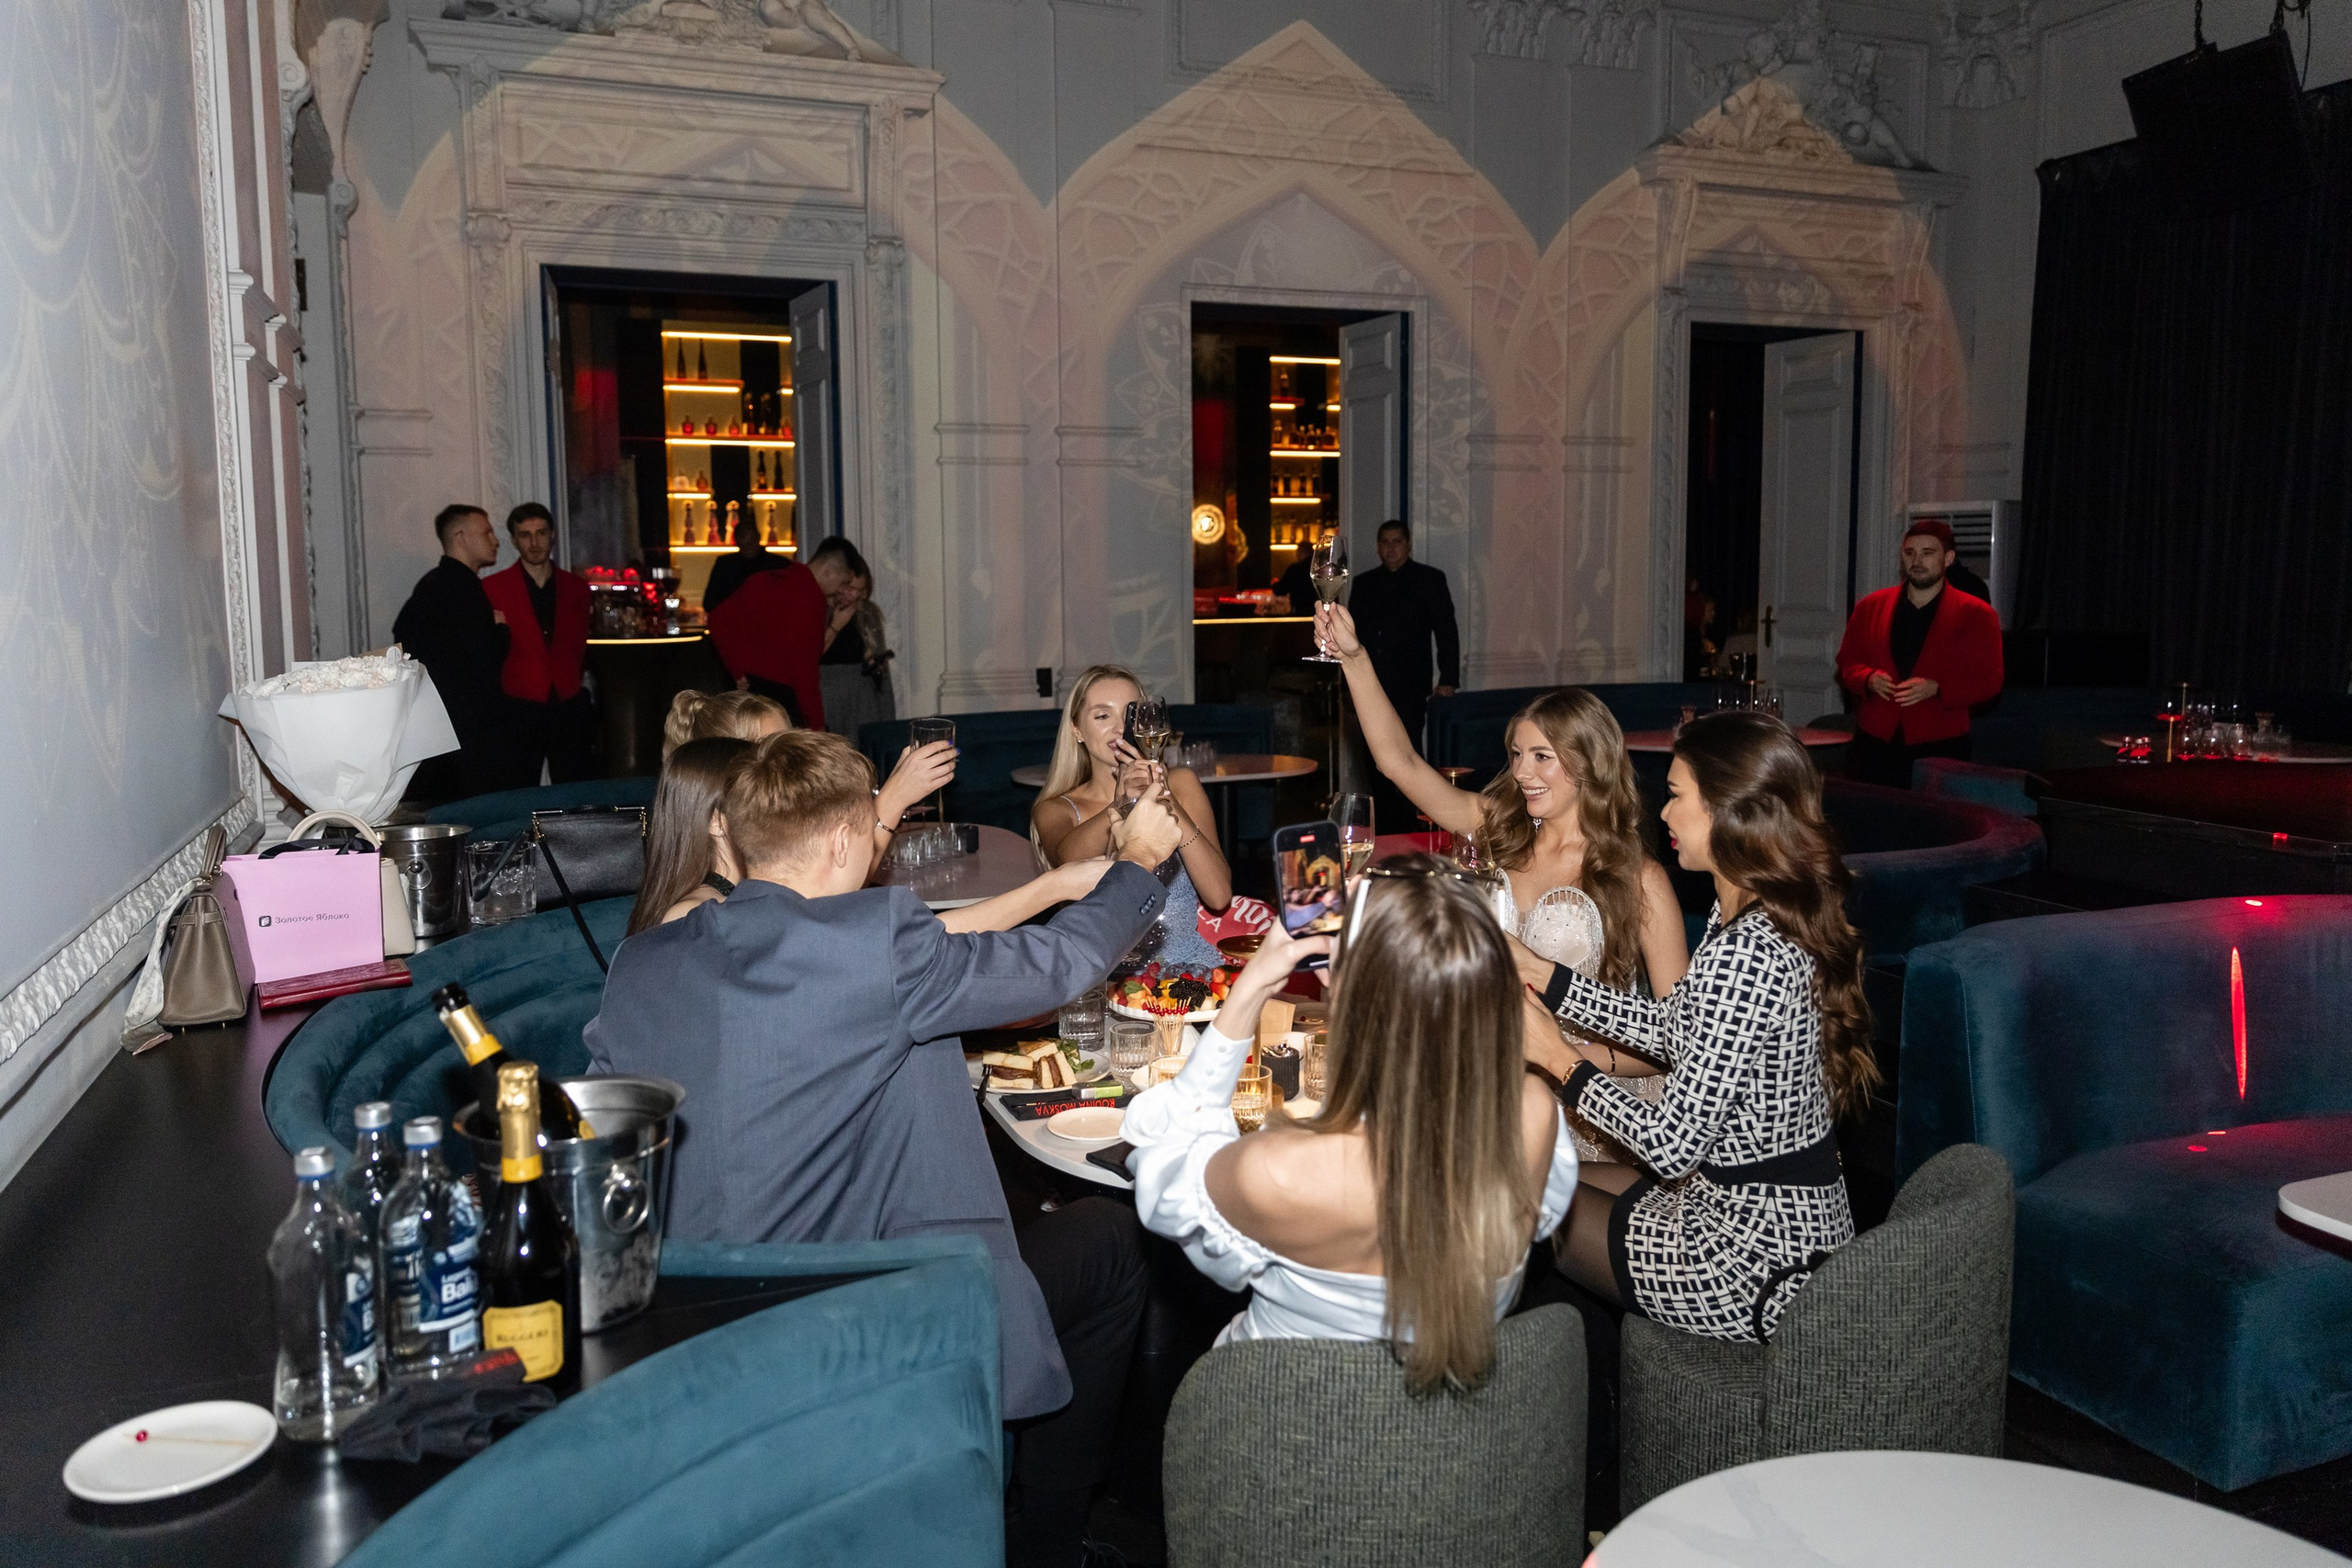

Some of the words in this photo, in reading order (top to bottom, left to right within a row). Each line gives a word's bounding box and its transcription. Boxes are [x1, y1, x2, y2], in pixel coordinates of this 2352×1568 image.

[275, 916, 314, 924] Золотое
[315, 912, 350, 921] Яблоко
[1035, 1100, 1077, 1117] MOSKVA
[1078, 1098, 1115, 1109] RODINA
